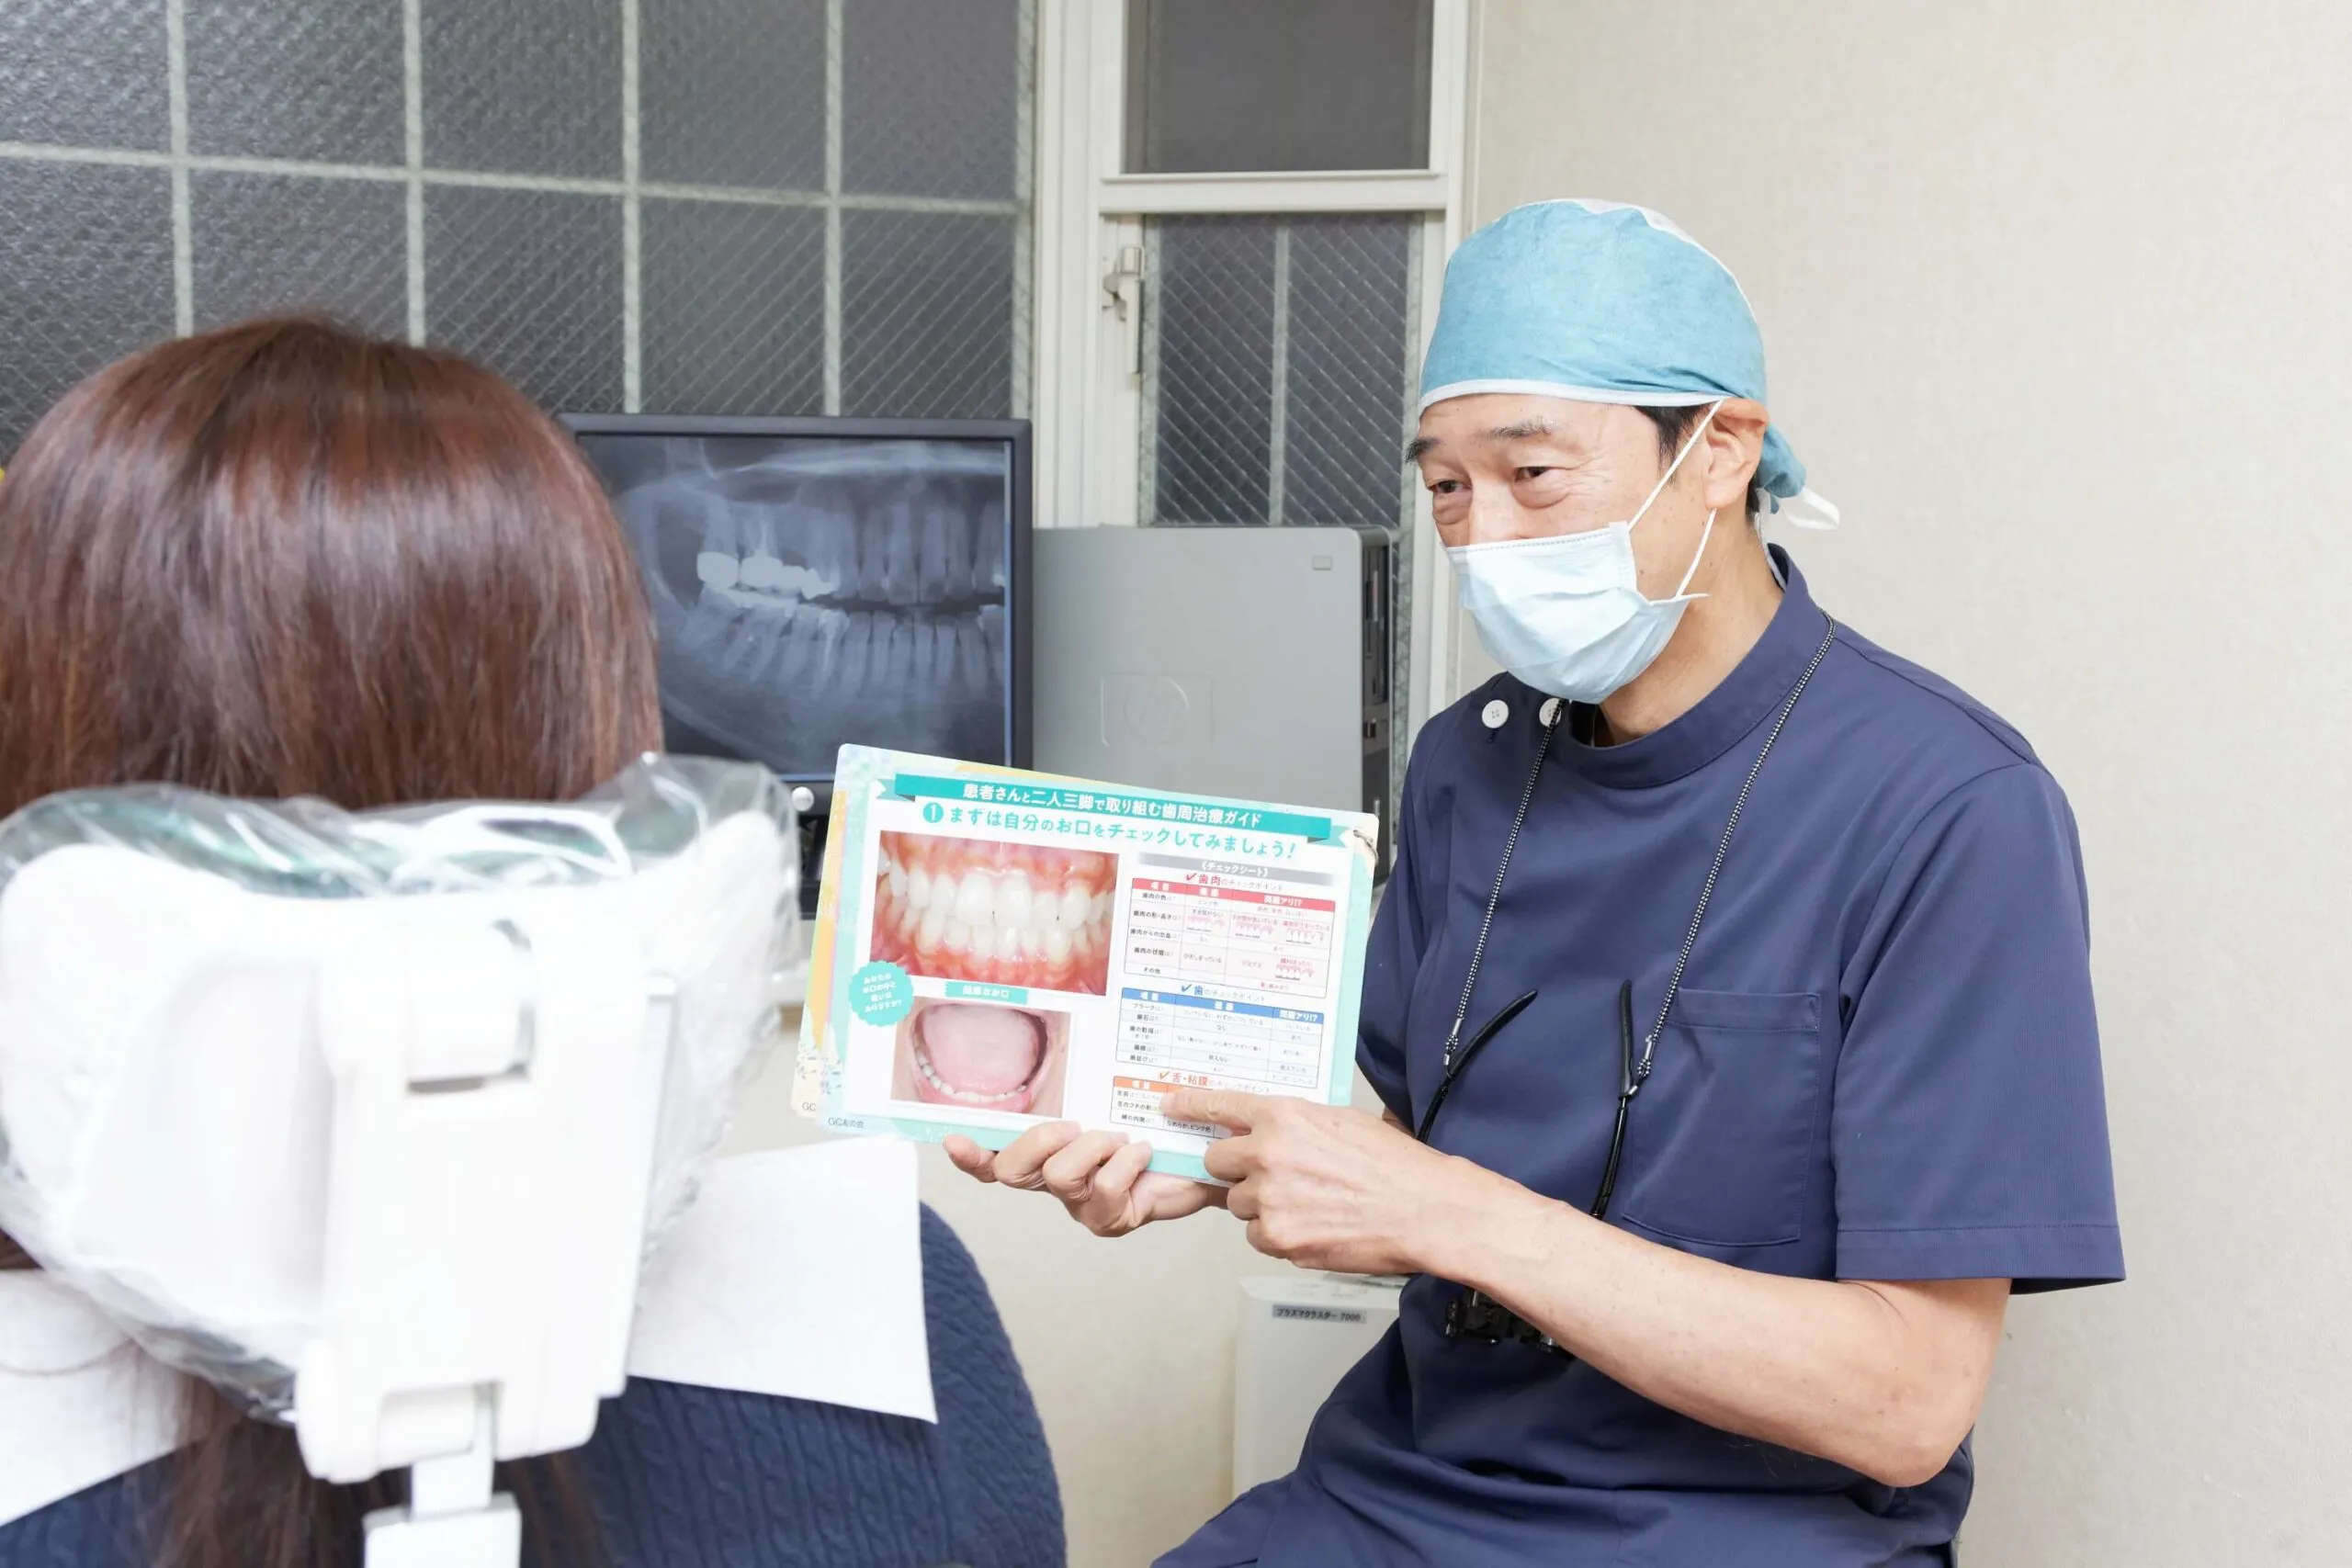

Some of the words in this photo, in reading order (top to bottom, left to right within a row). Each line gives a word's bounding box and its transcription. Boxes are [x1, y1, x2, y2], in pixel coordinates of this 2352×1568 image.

[962, 783, 1262, 829] 患者さんと二人三脚で取り組む歯周治療ガイド
[801, 1101, 816, 1111] GC
